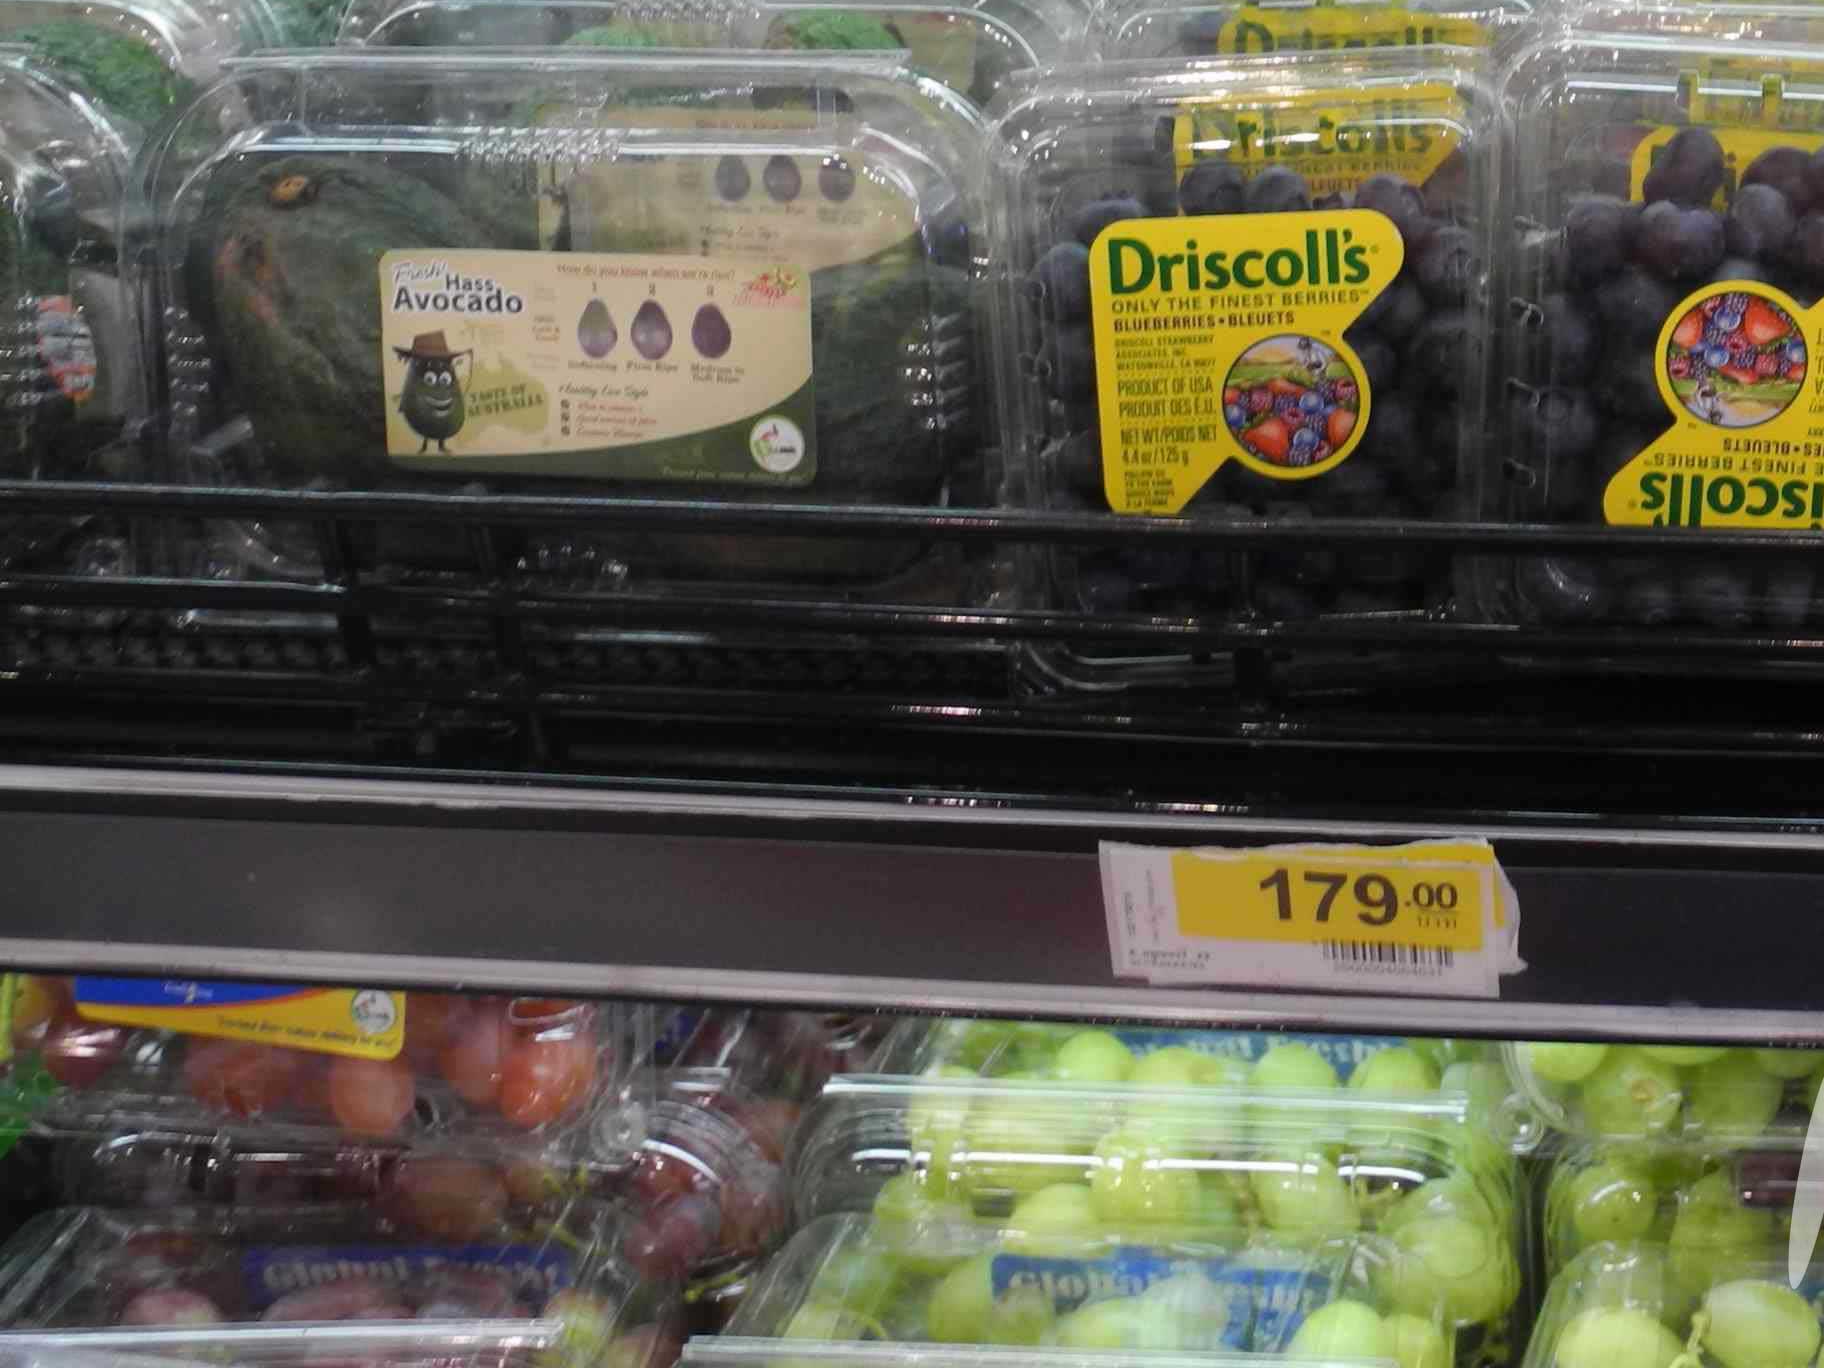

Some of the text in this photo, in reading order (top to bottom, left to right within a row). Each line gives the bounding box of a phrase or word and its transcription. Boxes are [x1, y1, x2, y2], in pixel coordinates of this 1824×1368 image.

[1109, 229, 1370, 295] Driscoll's
[445, 272, 495, 293] Hass
[393, 286, 524, 314] Avocado
[1112, 290, 1359, 314] ONLY THE FINEST BERRIES
[1114, 312, 1294, 332] BLUEBERRIES BLEUETS
[1118, 376, 1213, 396] PRODUCT OF USA
[1723, 437, 1789, 455] BLEUETS
[1653, 452, 1733, 469] BERRIES
[1740, 457, 1806, 474] FINEST
